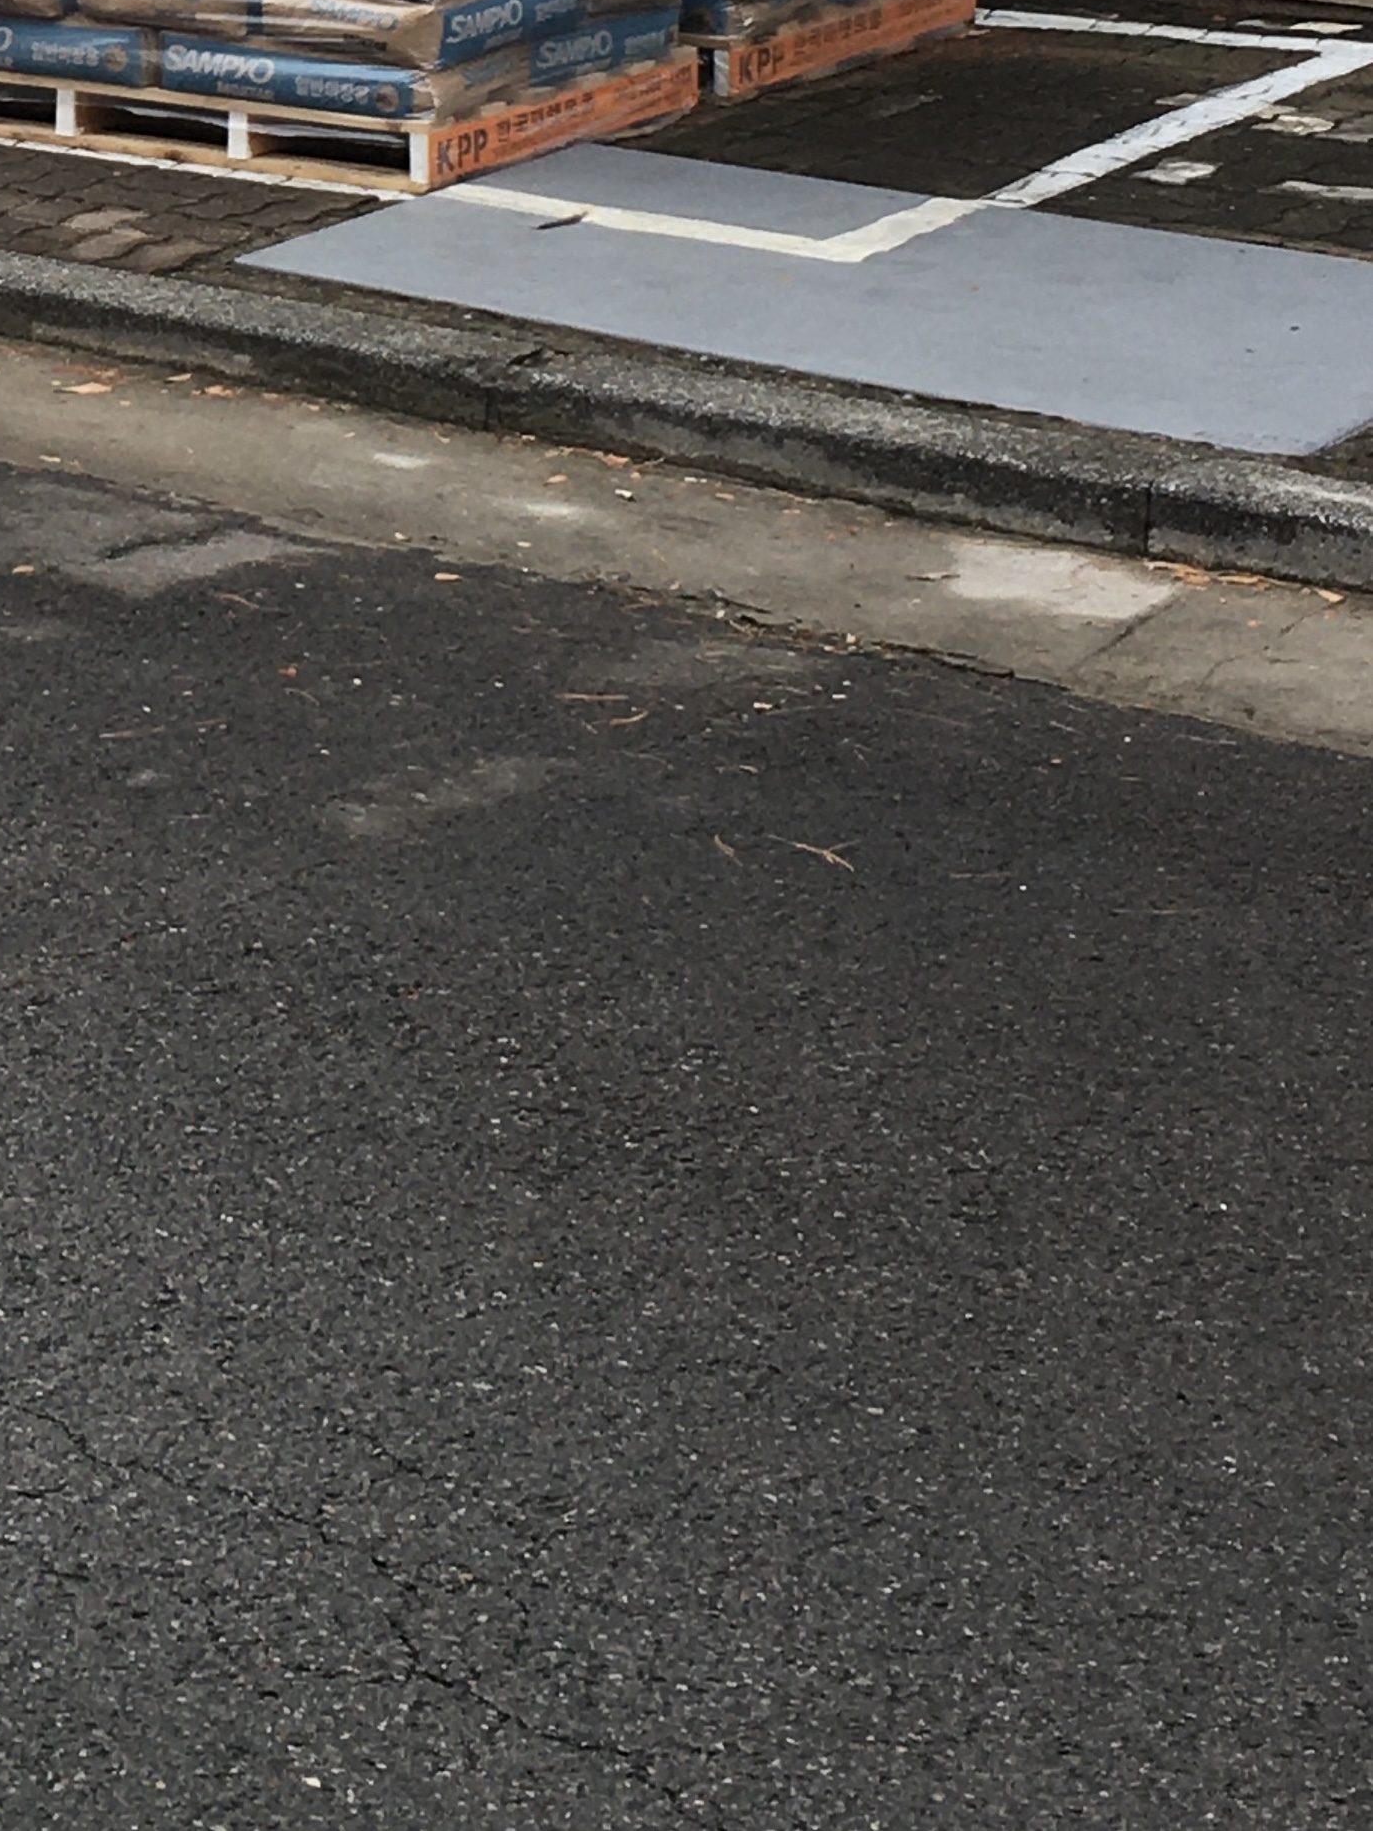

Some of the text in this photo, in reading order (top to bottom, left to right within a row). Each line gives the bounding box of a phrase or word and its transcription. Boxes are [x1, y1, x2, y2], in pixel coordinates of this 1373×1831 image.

[163, 44, 276, 84] SAMPYO
[537, 30, 613, 69] SAMPYO
[434, 128, 489, 175] KPP
